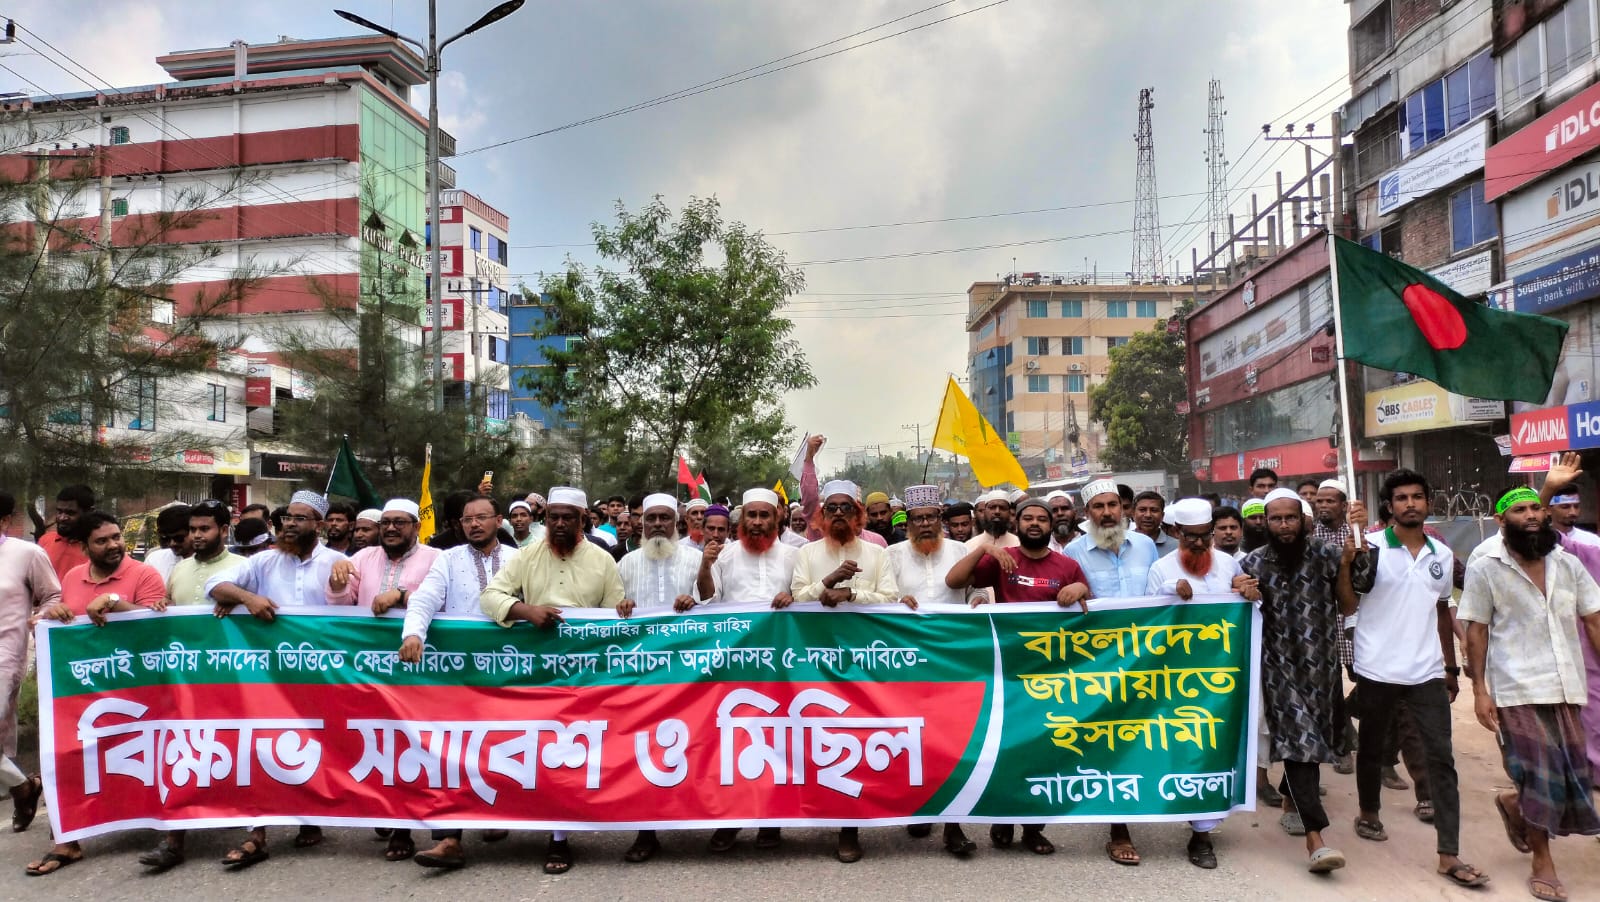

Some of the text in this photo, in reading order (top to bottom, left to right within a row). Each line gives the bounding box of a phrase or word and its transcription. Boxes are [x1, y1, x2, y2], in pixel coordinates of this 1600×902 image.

[1565, 172, 1600, 211] IDL
[362, 225, 394, 254] KUSUM
[399, 244, 425, 271] PLAZA
[1517, 270, 1562, 297] Southeast
[1562, 259, 1588, 281] Bank
[1566, 280, 1585, 295] with
[1385, 398, 1433, 416] BBS CABLES
[1525, 418, 1568, 444] JAMUNA
[712, 618, 752, 634] রাহিম
[1018, 618, 1237, 662] বাংলাদেশ
[69, 648, 135, 687] জুলাই
[141, 642, 202, 673] জাতীয়
[206, 649, 271, 672] সনদের
[276, 642, 347, 673] ভিত্তিতে
[472, 644, 536, 675] জাতীয়
[541, 652, 599, 675] সংসদ
[606, 643, 673, 674] নির্বাচন
[679, 646, 776, 676] অনুষ্ঠানসহ
[781, 645, 844, 673] ৫-দফা
[852, 640, 928, 671] দাবিতে-
[1017, 665, 1240, 705] জামায়াতে
[78, 688, 925, 805] বিক্ষোভ সমাবেশ ও মিছিল
[1043, 706, 1224, 757] ইসলামী
[1026, 766, 1237, 805] নাটোর জেলা
